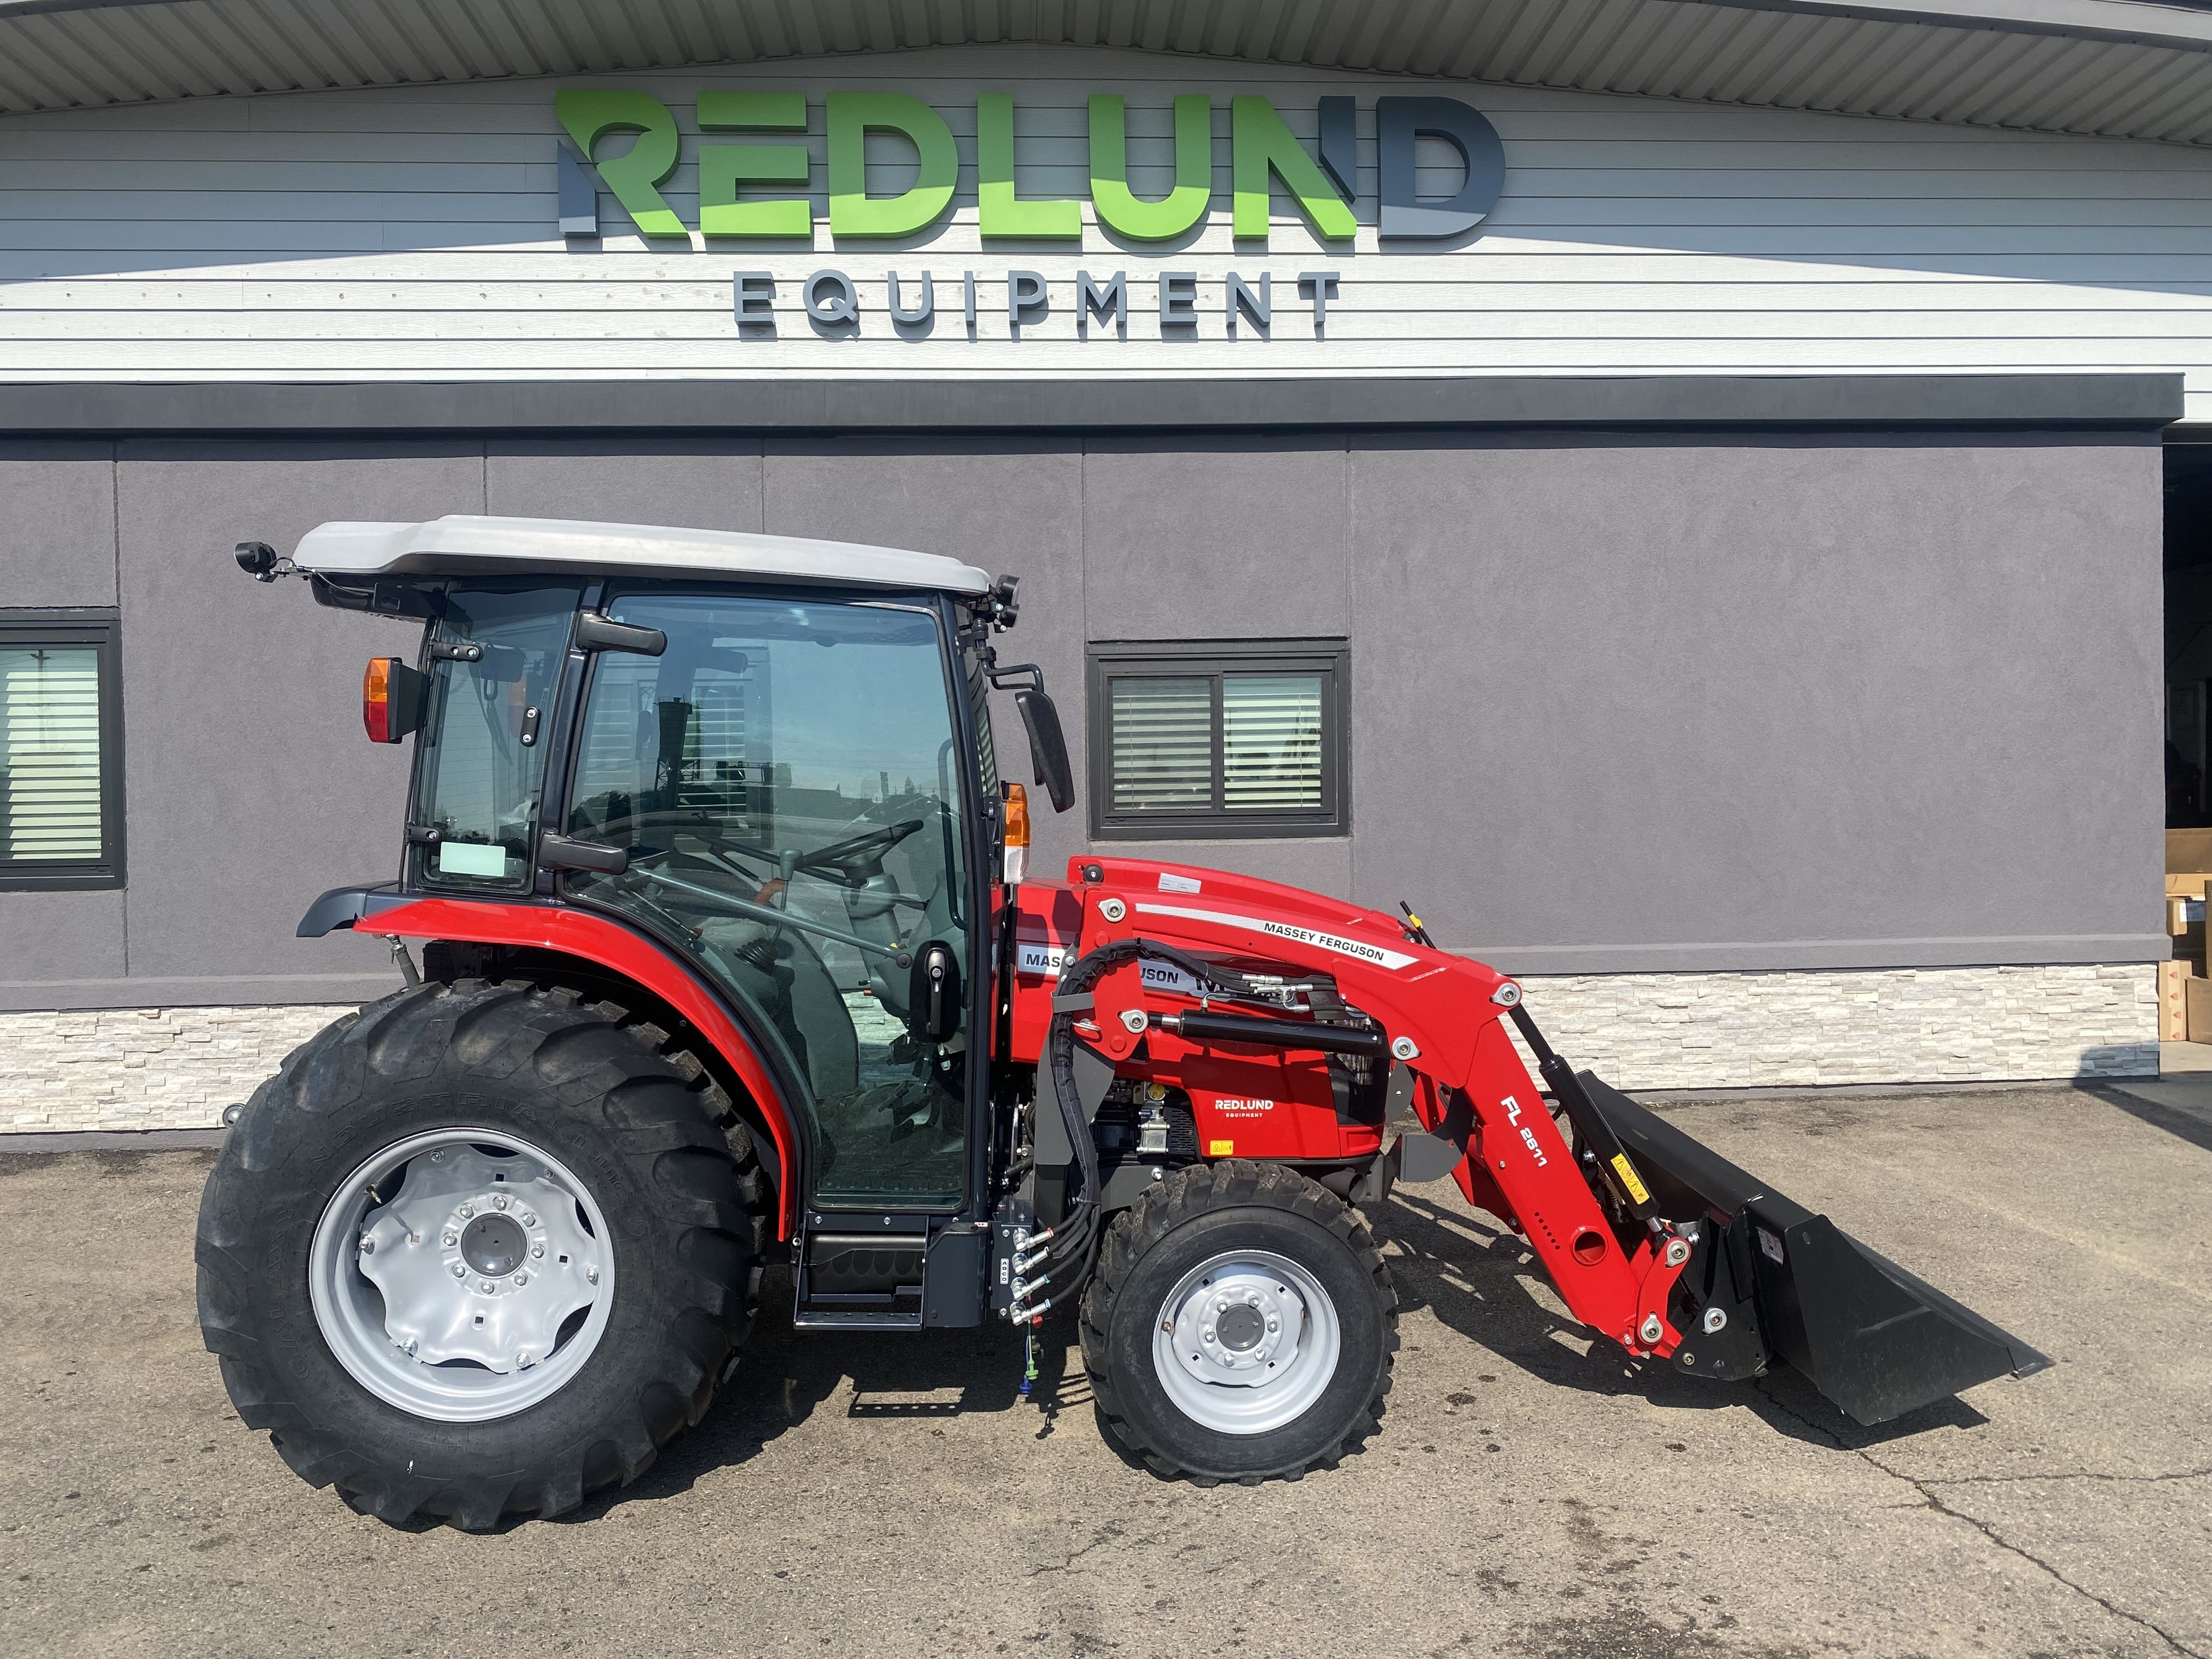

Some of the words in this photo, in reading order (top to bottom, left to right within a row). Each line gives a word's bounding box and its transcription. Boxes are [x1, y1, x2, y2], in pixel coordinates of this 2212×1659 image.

[557, 91, 1505, 241] REDLUND
[733, 269, 1340, 327] EQUIPMENT
[1026, 953, 1060, 968] MAS
[1264, 922, 1316, 941] MASSEY
[1319, 935, 1385, 961] FERGUSON
[1215, 1099, 1274, 1110] REDLUND
[1500, 1095, 1522, 1127] FL
[1519, 1126, 1548, 1167] 2611
